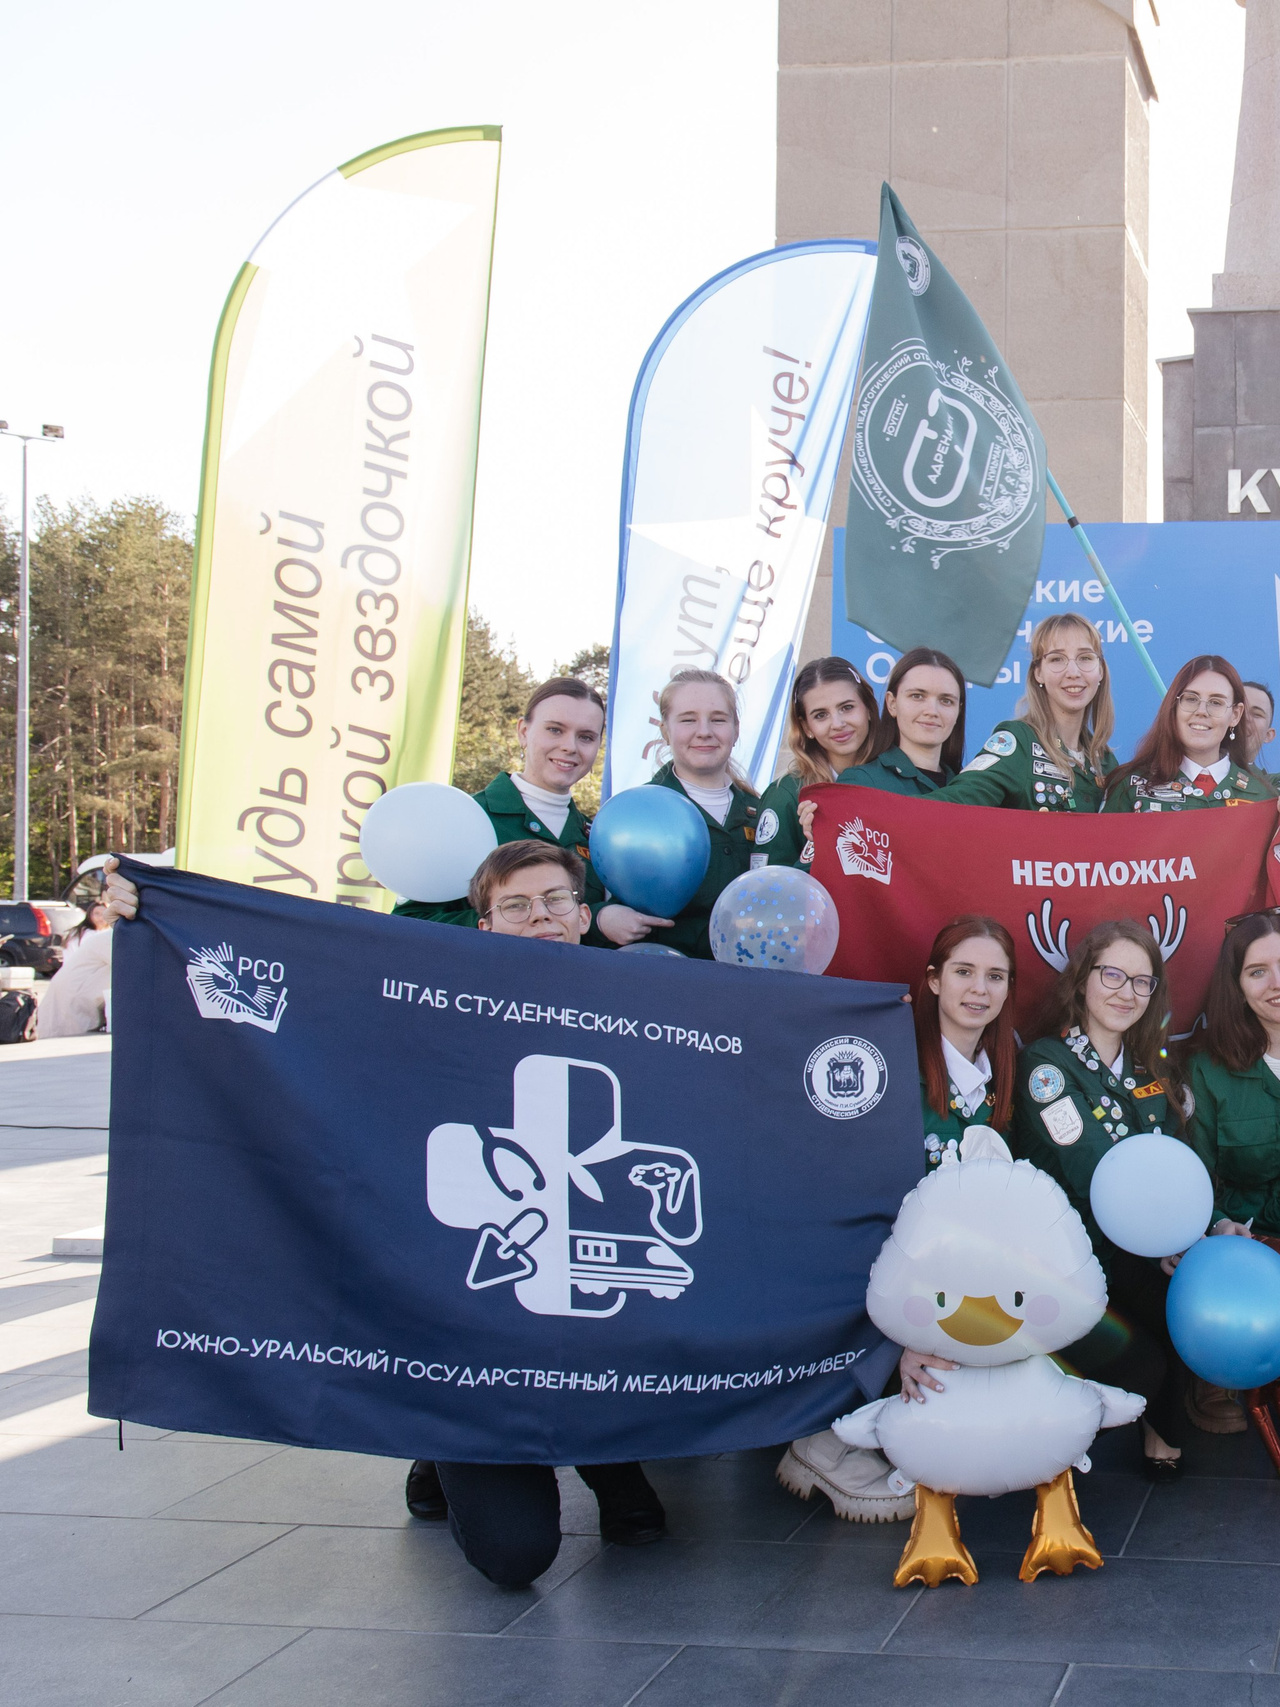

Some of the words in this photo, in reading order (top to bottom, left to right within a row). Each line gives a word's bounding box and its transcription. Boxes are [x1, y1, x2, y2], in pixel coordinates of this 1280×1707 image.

[856, 353, 912, 429] ПЕДАГОГИЧЕСКИЙ
[756, 345, 812, 538] круче!
[855, 431, 892, 509] СТУДЕНЧЕСКИЙ
[341, 332, 415, 702] звездочкой
[259, 510, 327, 738] самой
[237, 767, 318, 893] удь
[865, 827, 890, 848] РСО
[1011, 856, 1197, 887] НЕОТЛОЖКА
[238, 956, 285, 983] РСО
[382, 978, 448, 1009] ШТАБ
[455, 993, 638, 1038] СТУДЕНЧЕСКИХ
[644, 1022, 743, 1054] ОТРЯДОВ
[806, 1038, 850, 1073] ЧЕЛЯБИНСКИЙ
[852, 1039, 885, 1072] ОБЛАСТНОЙ
[156, 1329, 389, 1373] ЮЖНО-УРАЛЬСКИЙ
[393, 1357, 619, 1392] ГОСУДАРСТВЕННЫЙ
[622, 1364, 783, 1394] МЕДИЦИНСКИЙ
